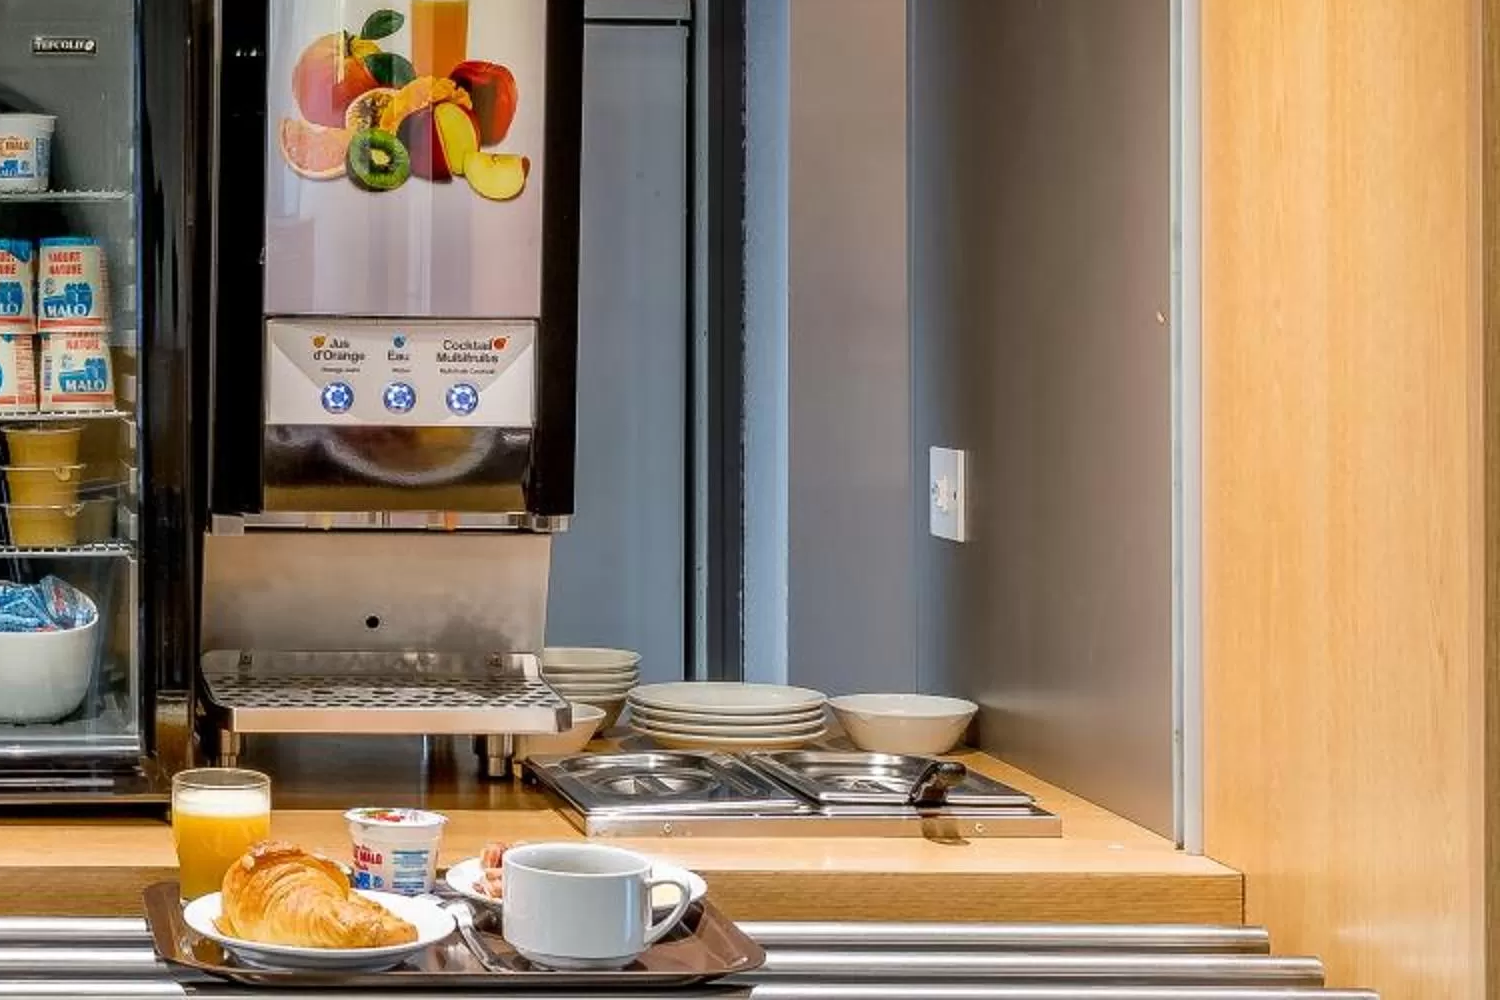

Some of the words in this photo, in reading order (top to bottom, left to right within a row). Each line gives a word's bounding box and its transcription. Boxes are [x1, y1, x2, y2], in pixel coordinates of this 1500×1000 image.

[47, 303, 87, 317] MALO
[329, 339, 350, 350] Jus
[443, 339, 493, 351] Cocktail
[313, 350, 366, 362] d'Orange
[64, 378, 106, 393] MALO
